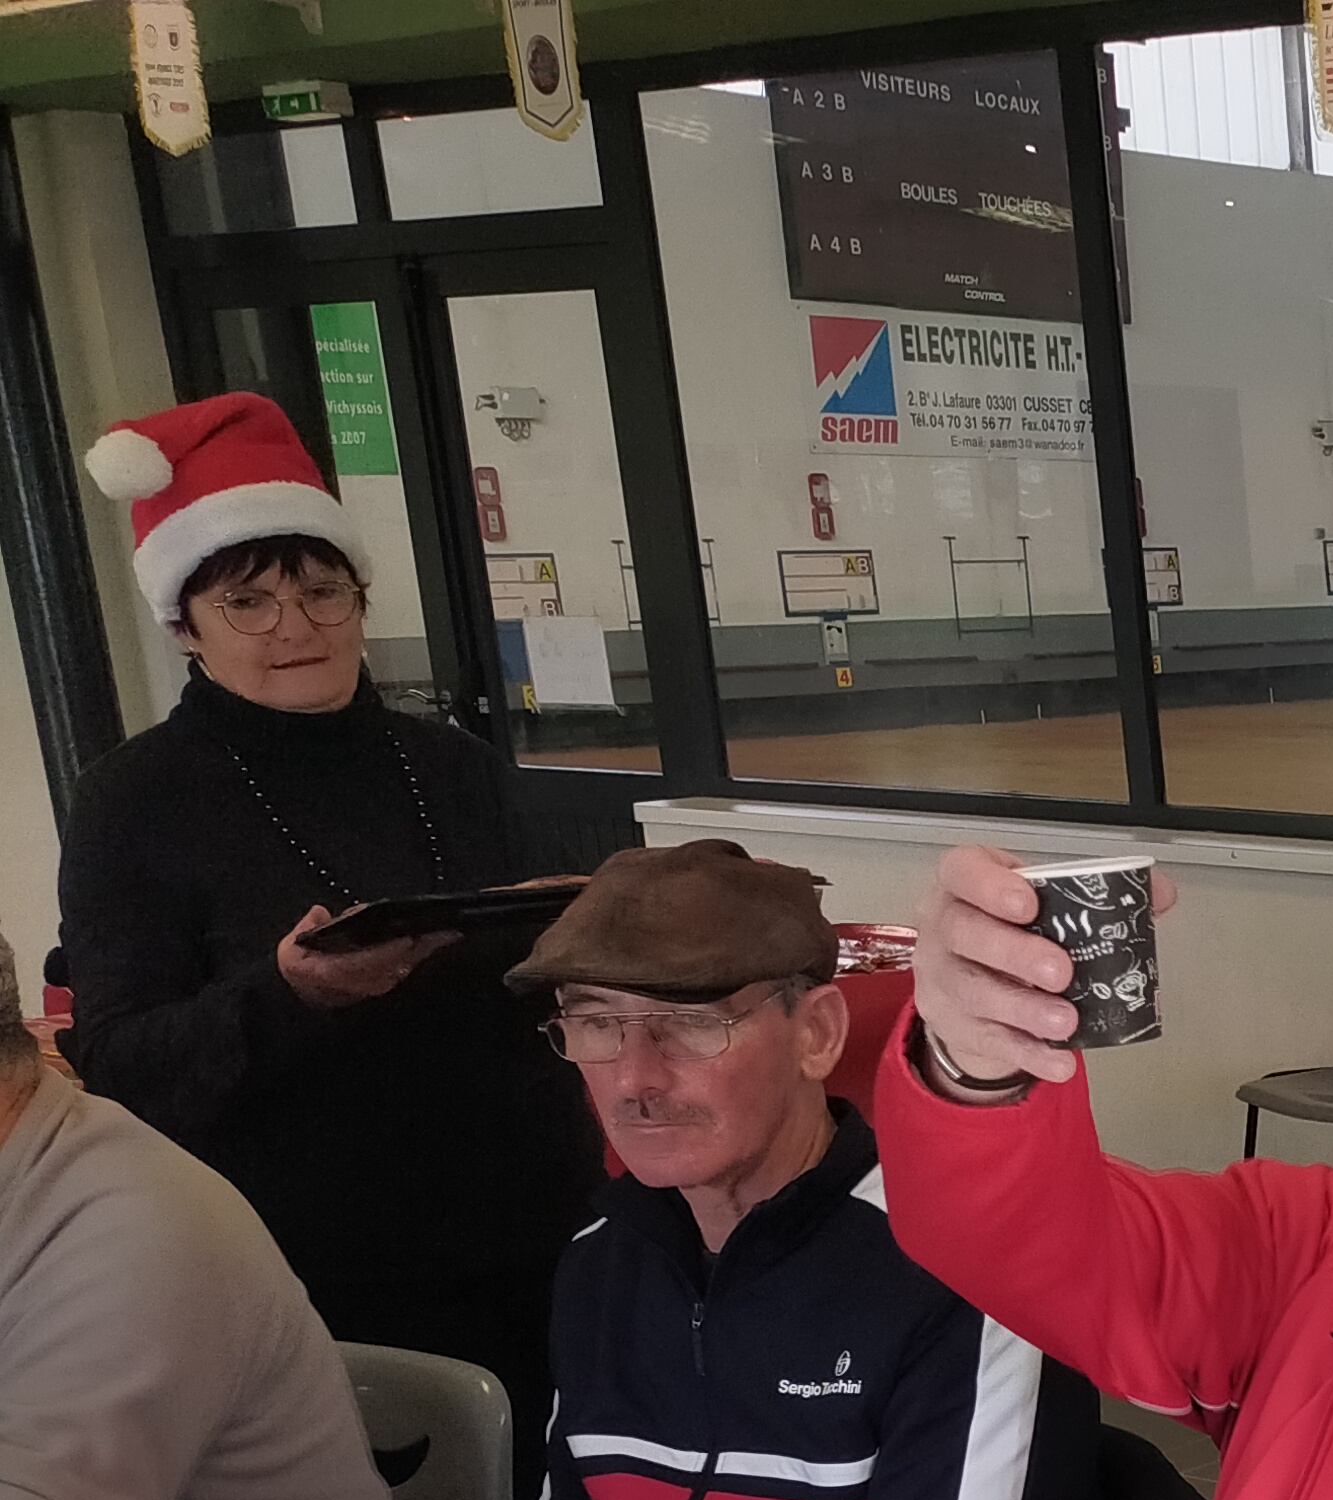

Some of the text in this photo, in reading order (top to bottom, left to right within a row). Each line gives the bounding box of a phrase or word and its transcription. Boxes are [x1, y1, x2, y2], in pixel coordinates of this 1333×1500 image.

[792, 88, 847, 111] A 2 B
[861, 69, 1041, 115] VISITEURS LOCAUX
[801, 160, 854, 184] A 3 B
[900, 182, 1053, 217] BOULES TOUCHÉES
[810, 233, 862, 255] A 4 B
[944, 273, 979, 286] MATCH
[900, 324, 1037, 370] ELECTRICITE
[357, 373, 374, 385] sur
[326, 398, 383, 419] Vichyssois
[986, 396, 1017, 412] 03301
[1023, 396, 1073, 415] CUSSET
[821, 415, 898, 445] saem
[964, 415, 979, 430] 31
[539, 562, 552, 579] A
[839, 670, 850, 685] 4
[778, 1379, 822, 1398] Sergio
